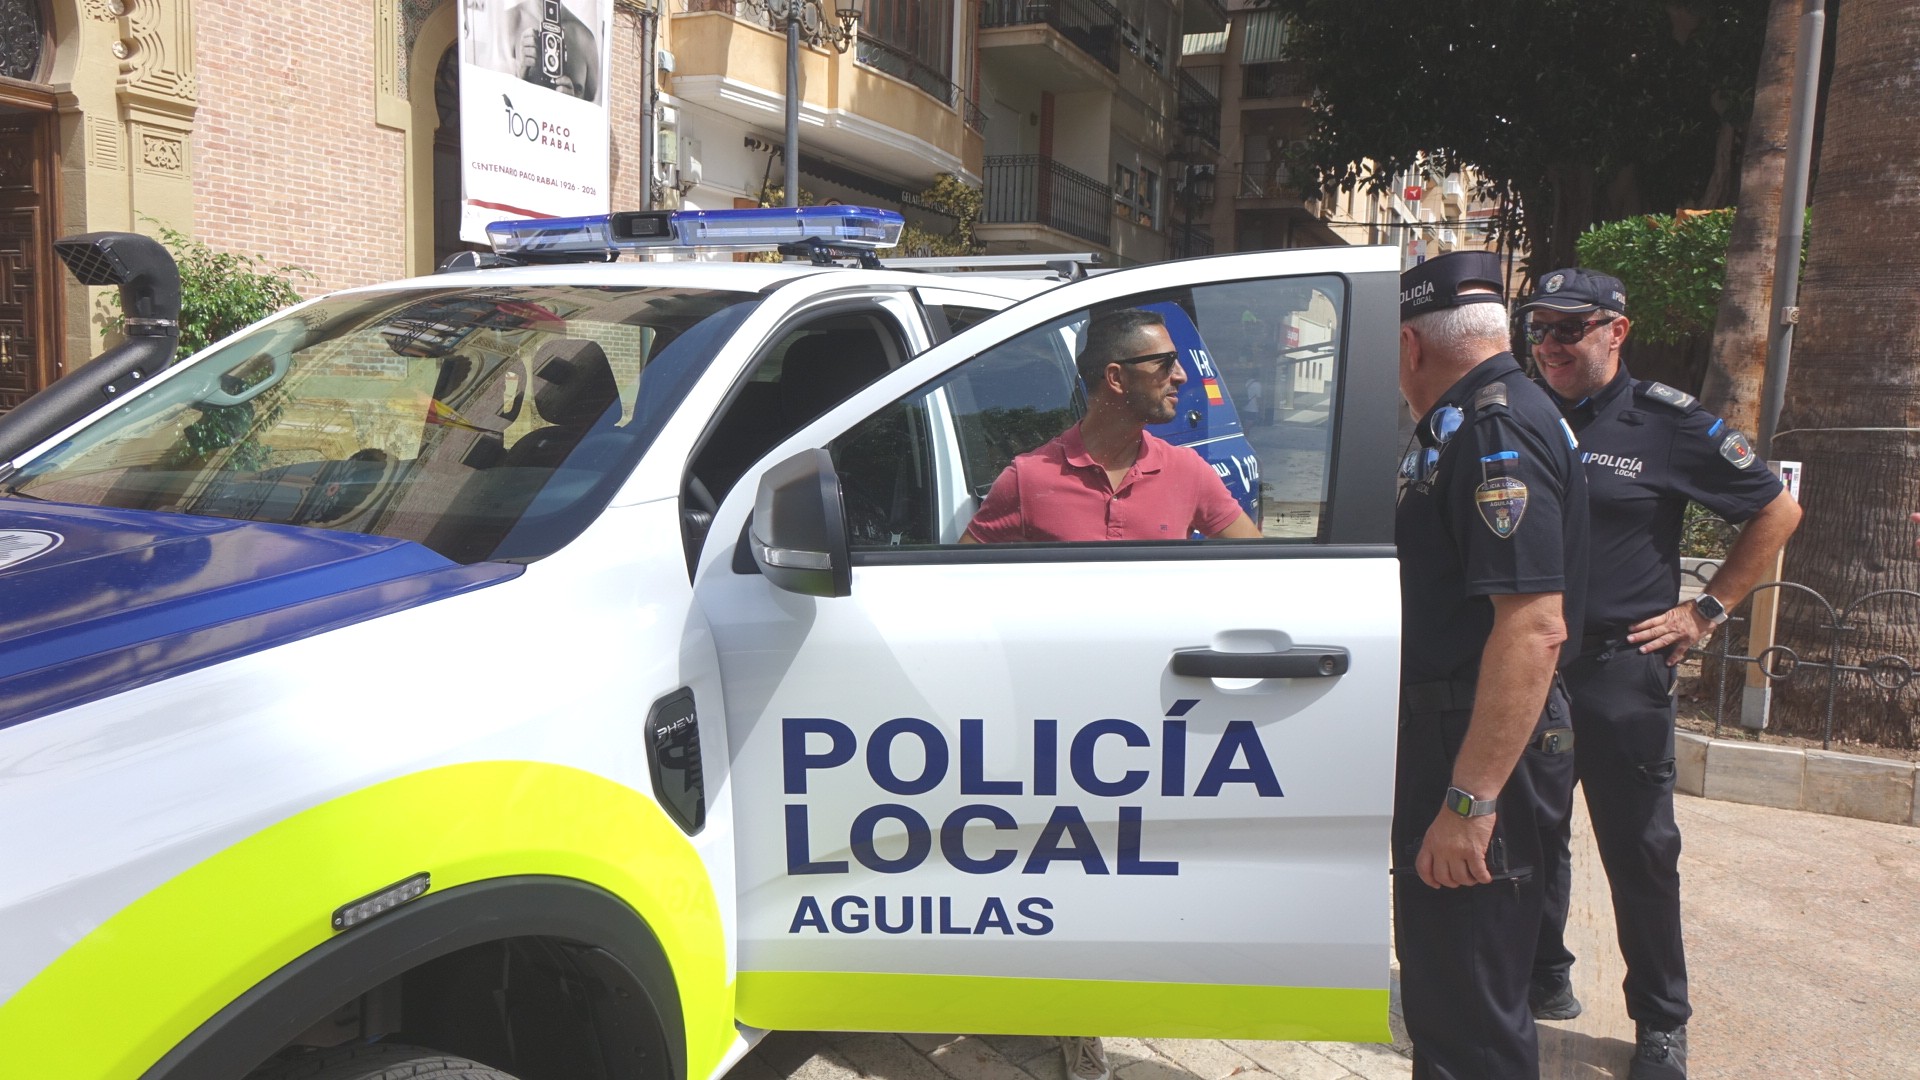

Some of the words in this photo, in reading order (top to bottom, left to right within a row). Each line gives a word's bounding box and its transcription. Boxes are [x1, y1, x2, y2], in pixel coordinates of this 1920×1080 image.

[505, 109, 539, 142] 100
[541, 121, 570, 138] PACO
[541, 135, 576, 153] RABAL
[472, 161, 518, 177] CENTENARIO
[519, 170, 535, 182] PACO
[536, 175, 559, 187] RABAL
[560, 180, 576, 191] 1926
[582, 185, 597, 196] 2026
[1400, 280, 1435, 304] OLICÍA
[1413, 295, 1433, 307] LOCAL
[1243, 454, 1259, 481] 112
[1588, 452, 1643, 473] POLICÍA
[1614, 468, 1636, 479] LOCAL
[1490, 499, 1514, 507] AGUILAS
[657, 713, 694, 739] PHEV
[781, 699, 1284, 798] POLICÍA
[785, 804, 1179, 876] LOCAL
[789, 895, 1055, 935] AGUILAS
